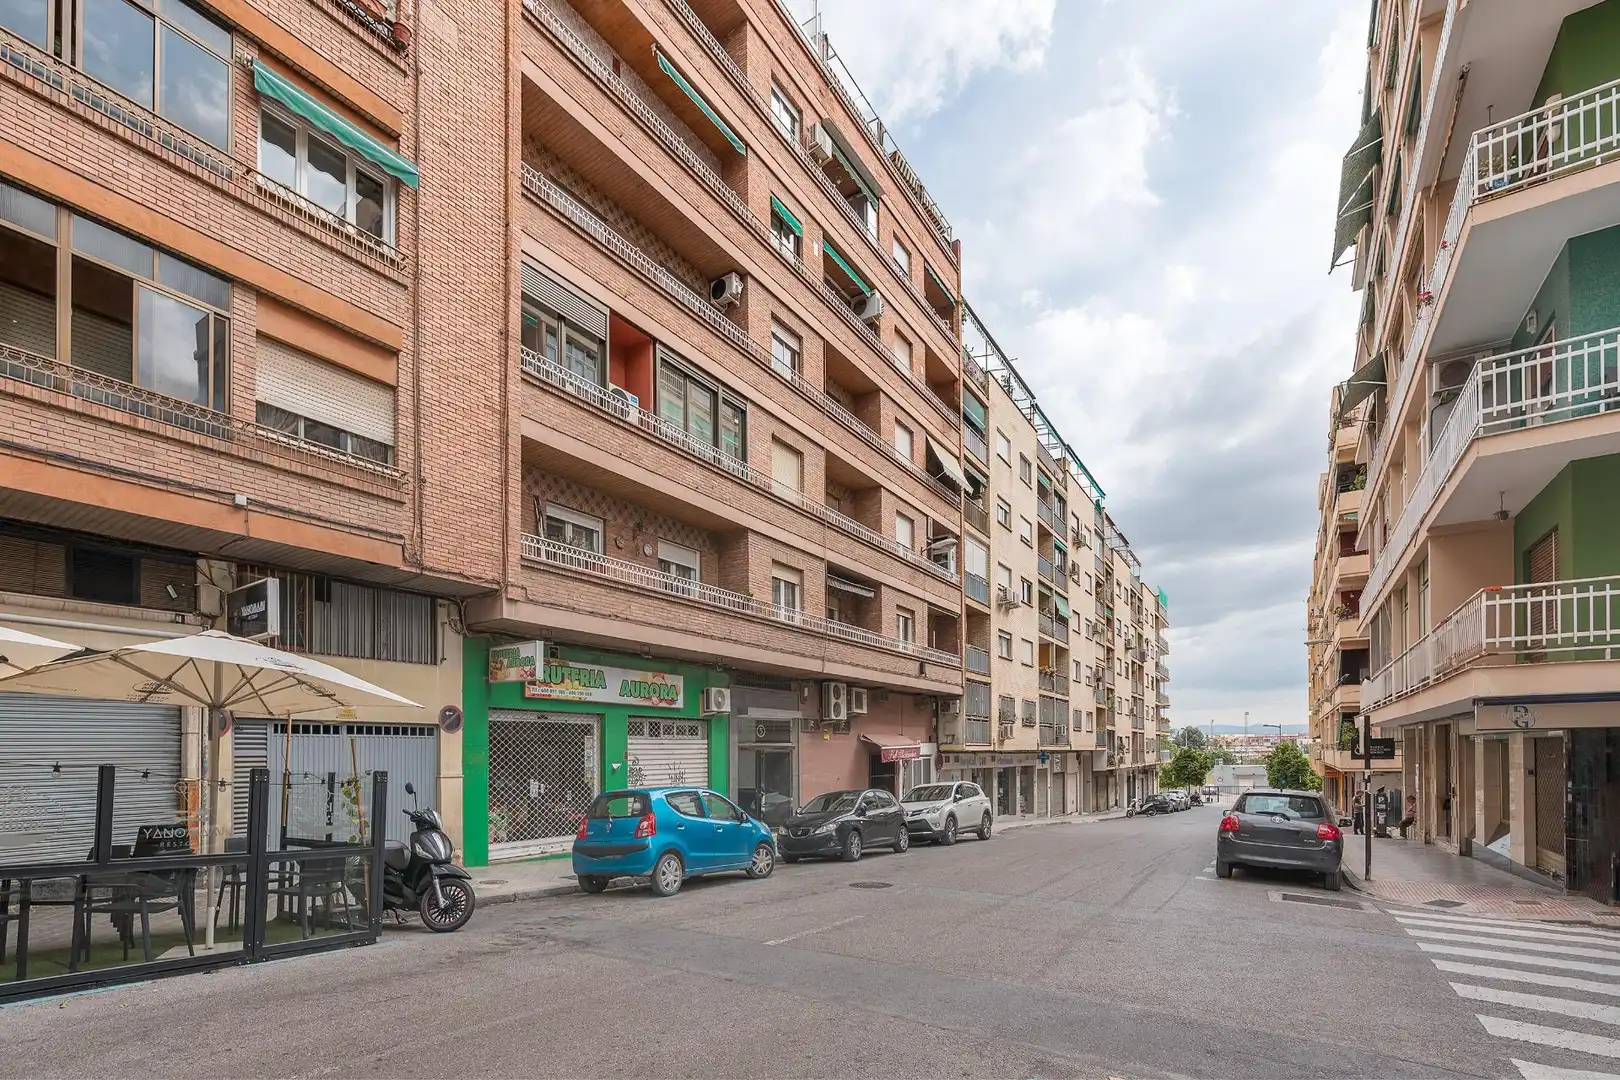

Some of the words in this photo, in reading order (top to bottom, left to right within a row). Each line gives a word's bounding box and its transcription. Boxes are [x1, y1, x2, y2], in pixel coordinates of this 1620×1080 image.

[506, 656, 535, 669] AURORA
[541, 665, 607, 690] RUTERIA
[618, 679, 679, 701] AURORA
